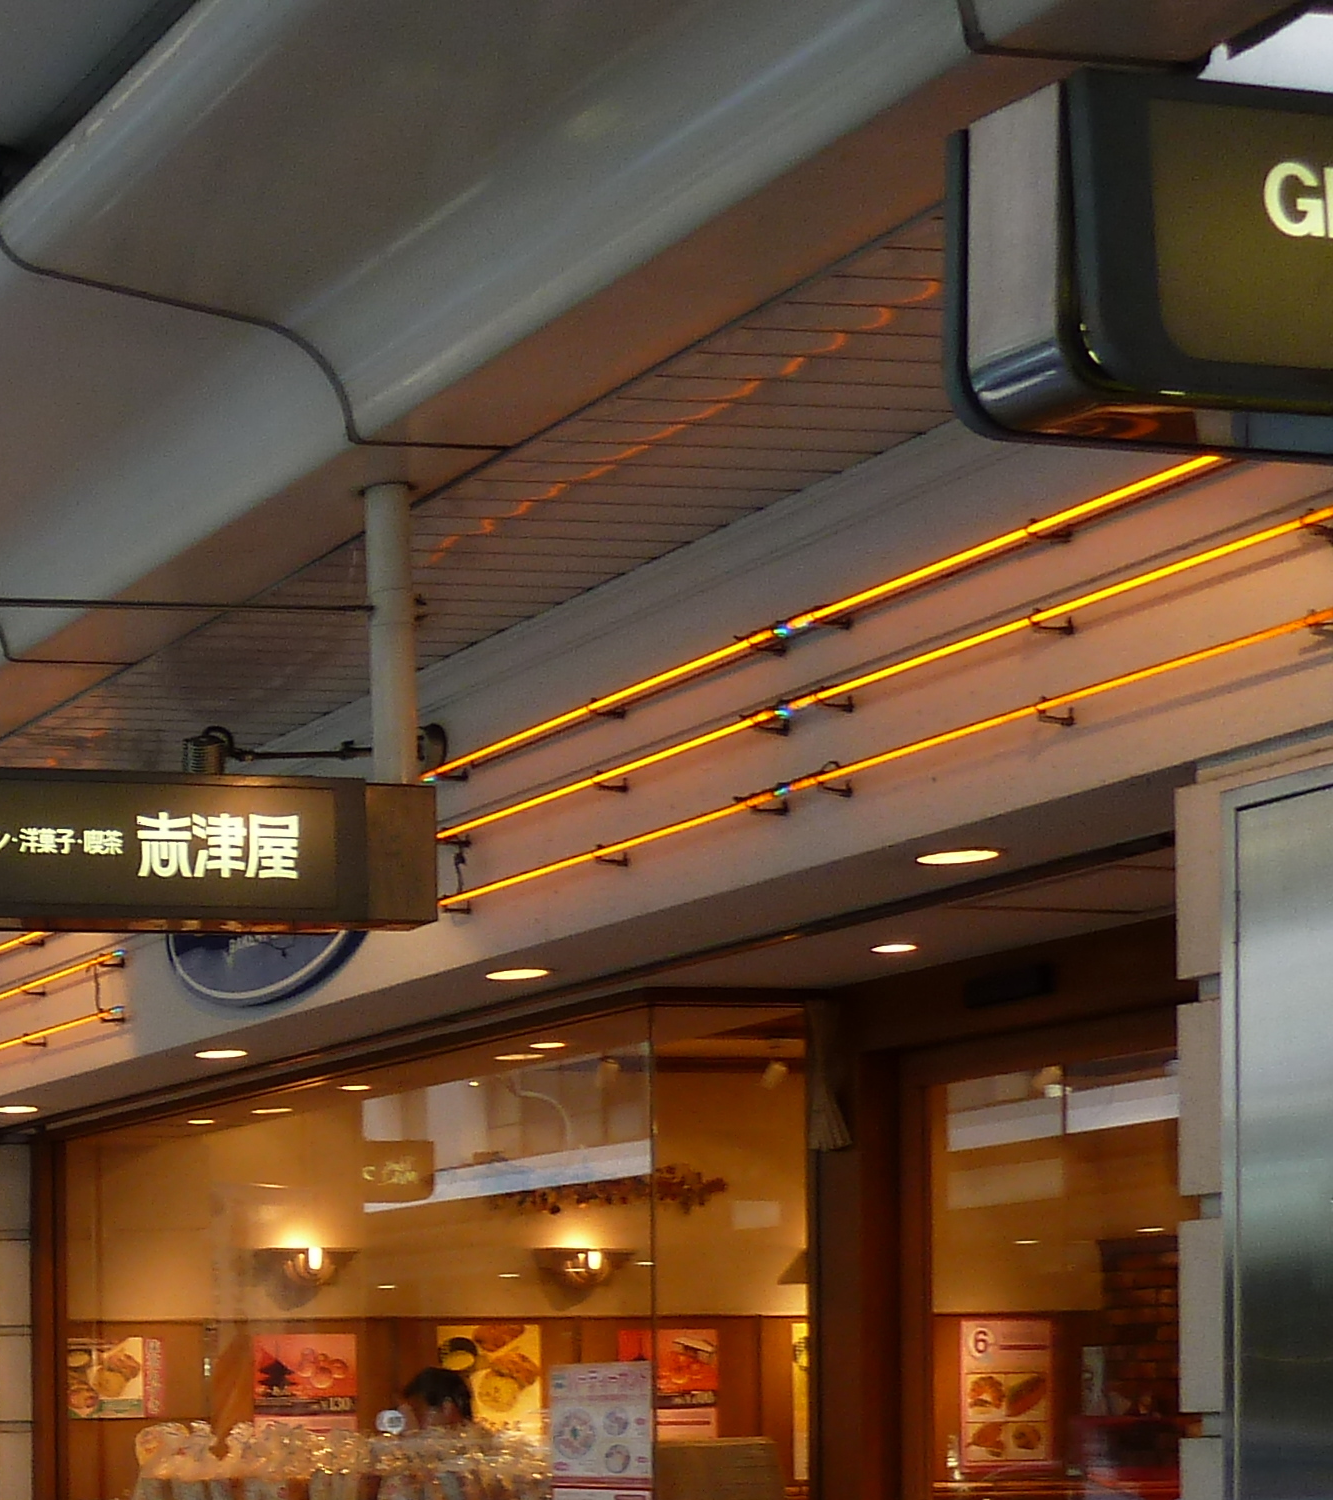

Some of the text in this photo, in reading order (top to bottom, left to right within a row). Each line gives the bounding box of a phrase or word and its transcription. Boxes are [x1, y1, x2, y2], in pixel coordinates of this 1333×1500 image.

[1264, 162, 1333, 238] G
[136, 811, 299, 879] 志津屋
[974, 1329, 989, 1354] 6
